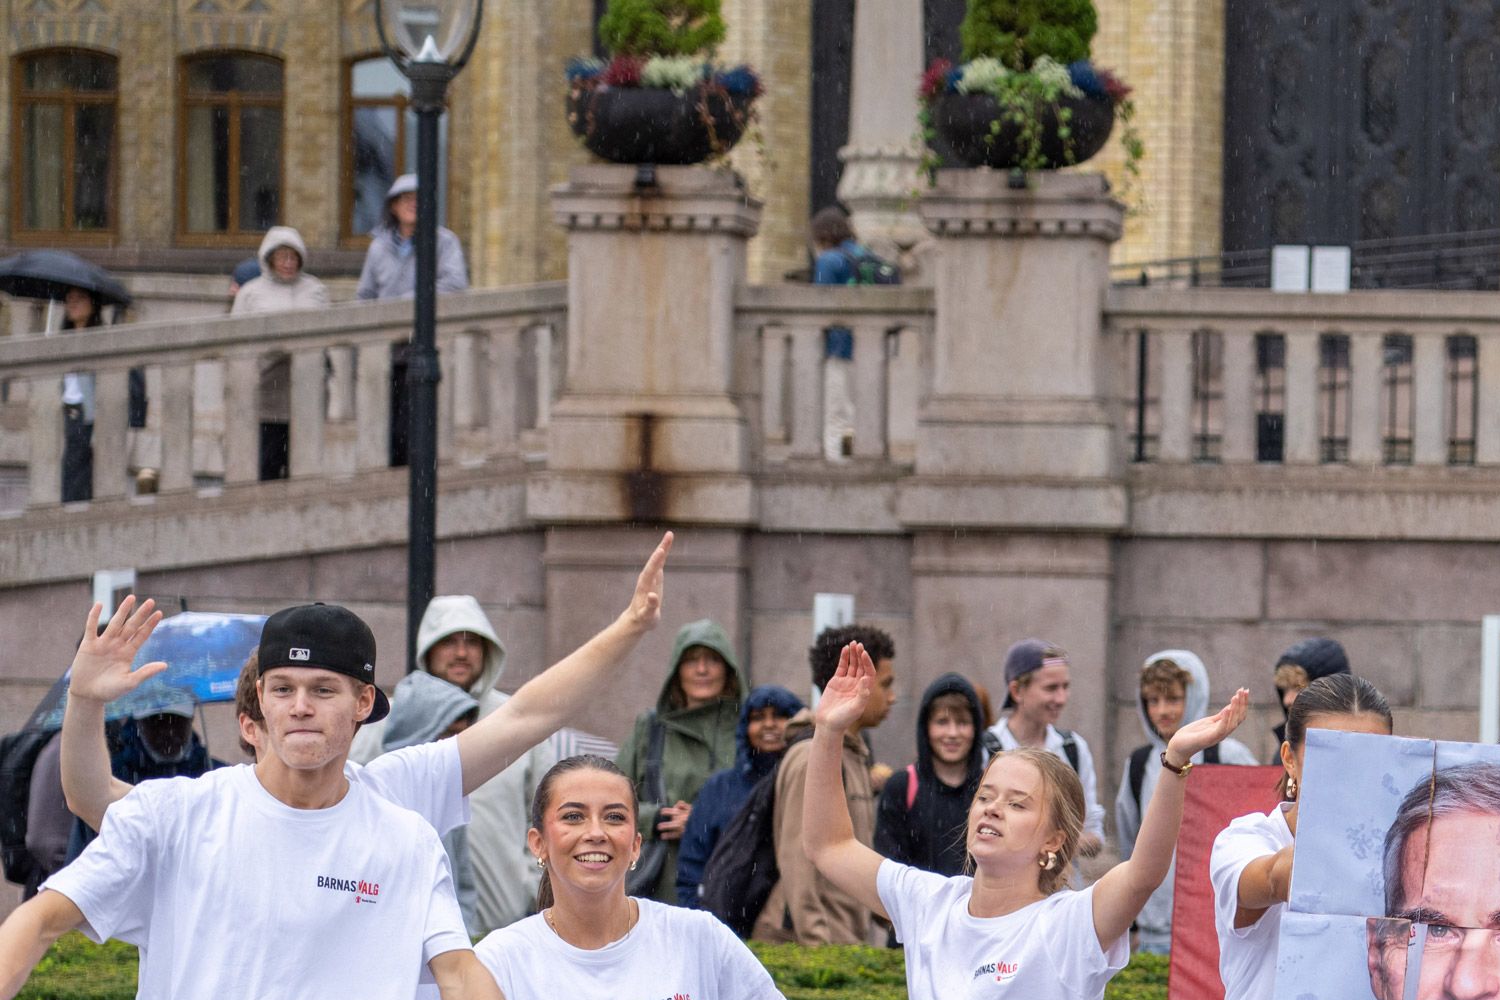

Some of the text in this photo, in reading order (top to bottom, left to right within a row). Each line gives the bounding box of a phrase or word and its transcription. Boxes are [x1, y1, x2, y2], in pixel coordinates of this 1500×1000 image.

[317, 876, 379, 896] BARNAS VALG
[997, 961, 1018, 974] VALG
